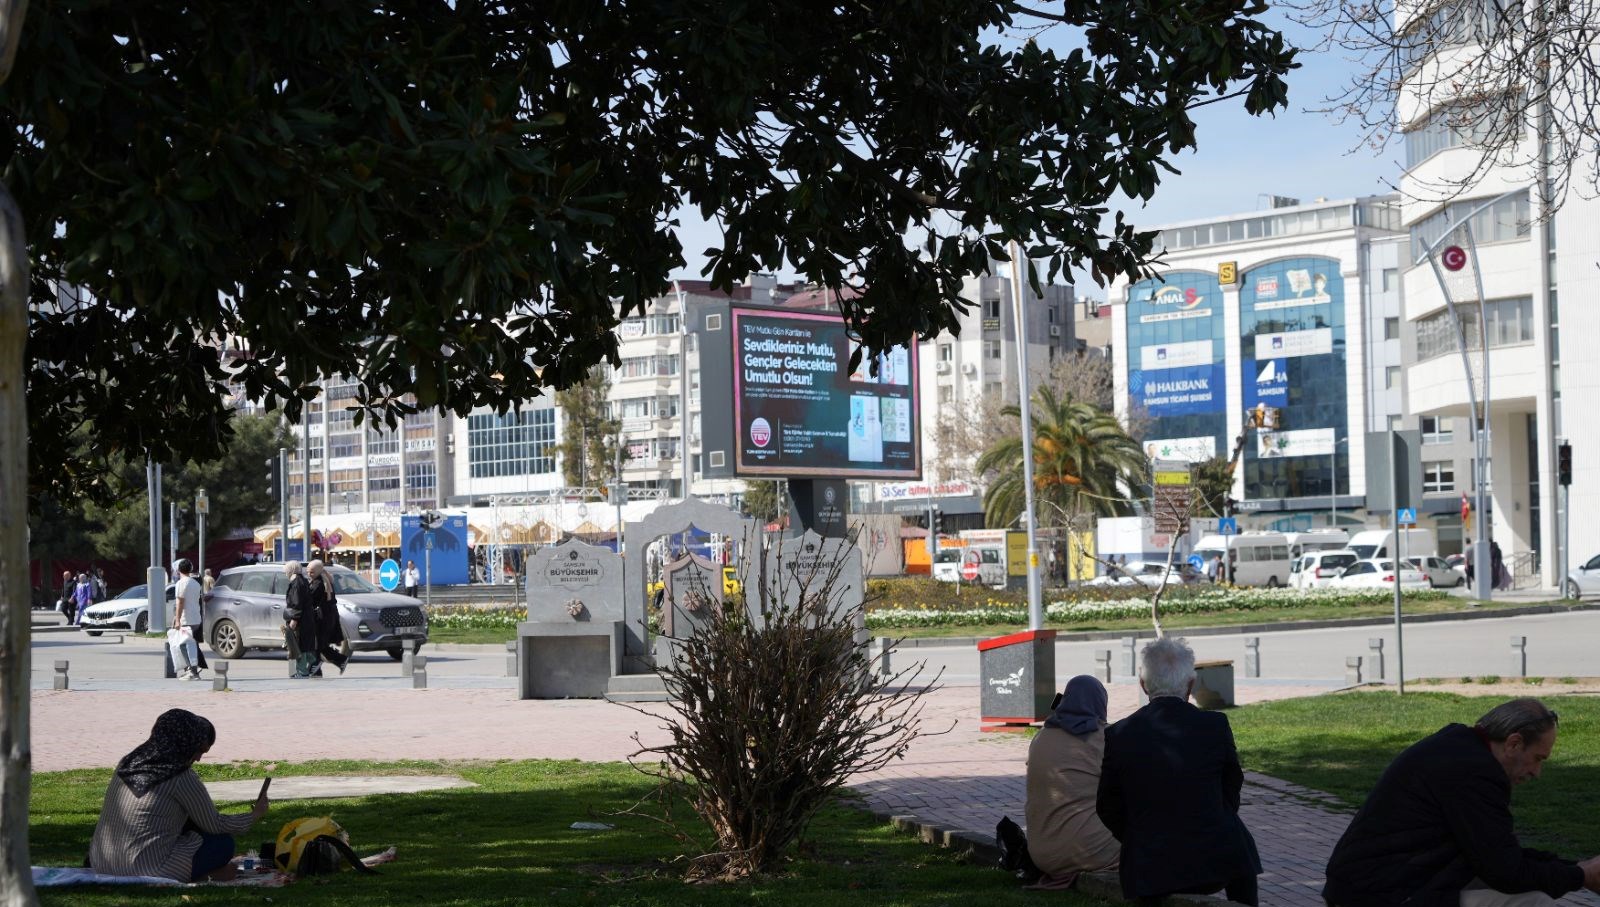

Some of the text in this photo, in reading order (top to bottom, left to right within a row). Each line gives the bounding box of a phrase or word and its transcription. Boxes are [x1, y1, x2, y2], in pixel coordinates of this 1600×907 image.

[744, 338, 836, 359] Sevdikleriniz Mutlu,
[744, 354, 838, 372] Gençler Gelecekten
[744, 369, 813, 386] Umutlu Olsun!
[1157, 379, 1209, 393] HALKBANK
[753, 432, 769, 441] TEV
[550, 567, 599, 577] BÜYÜKŞEHİR
